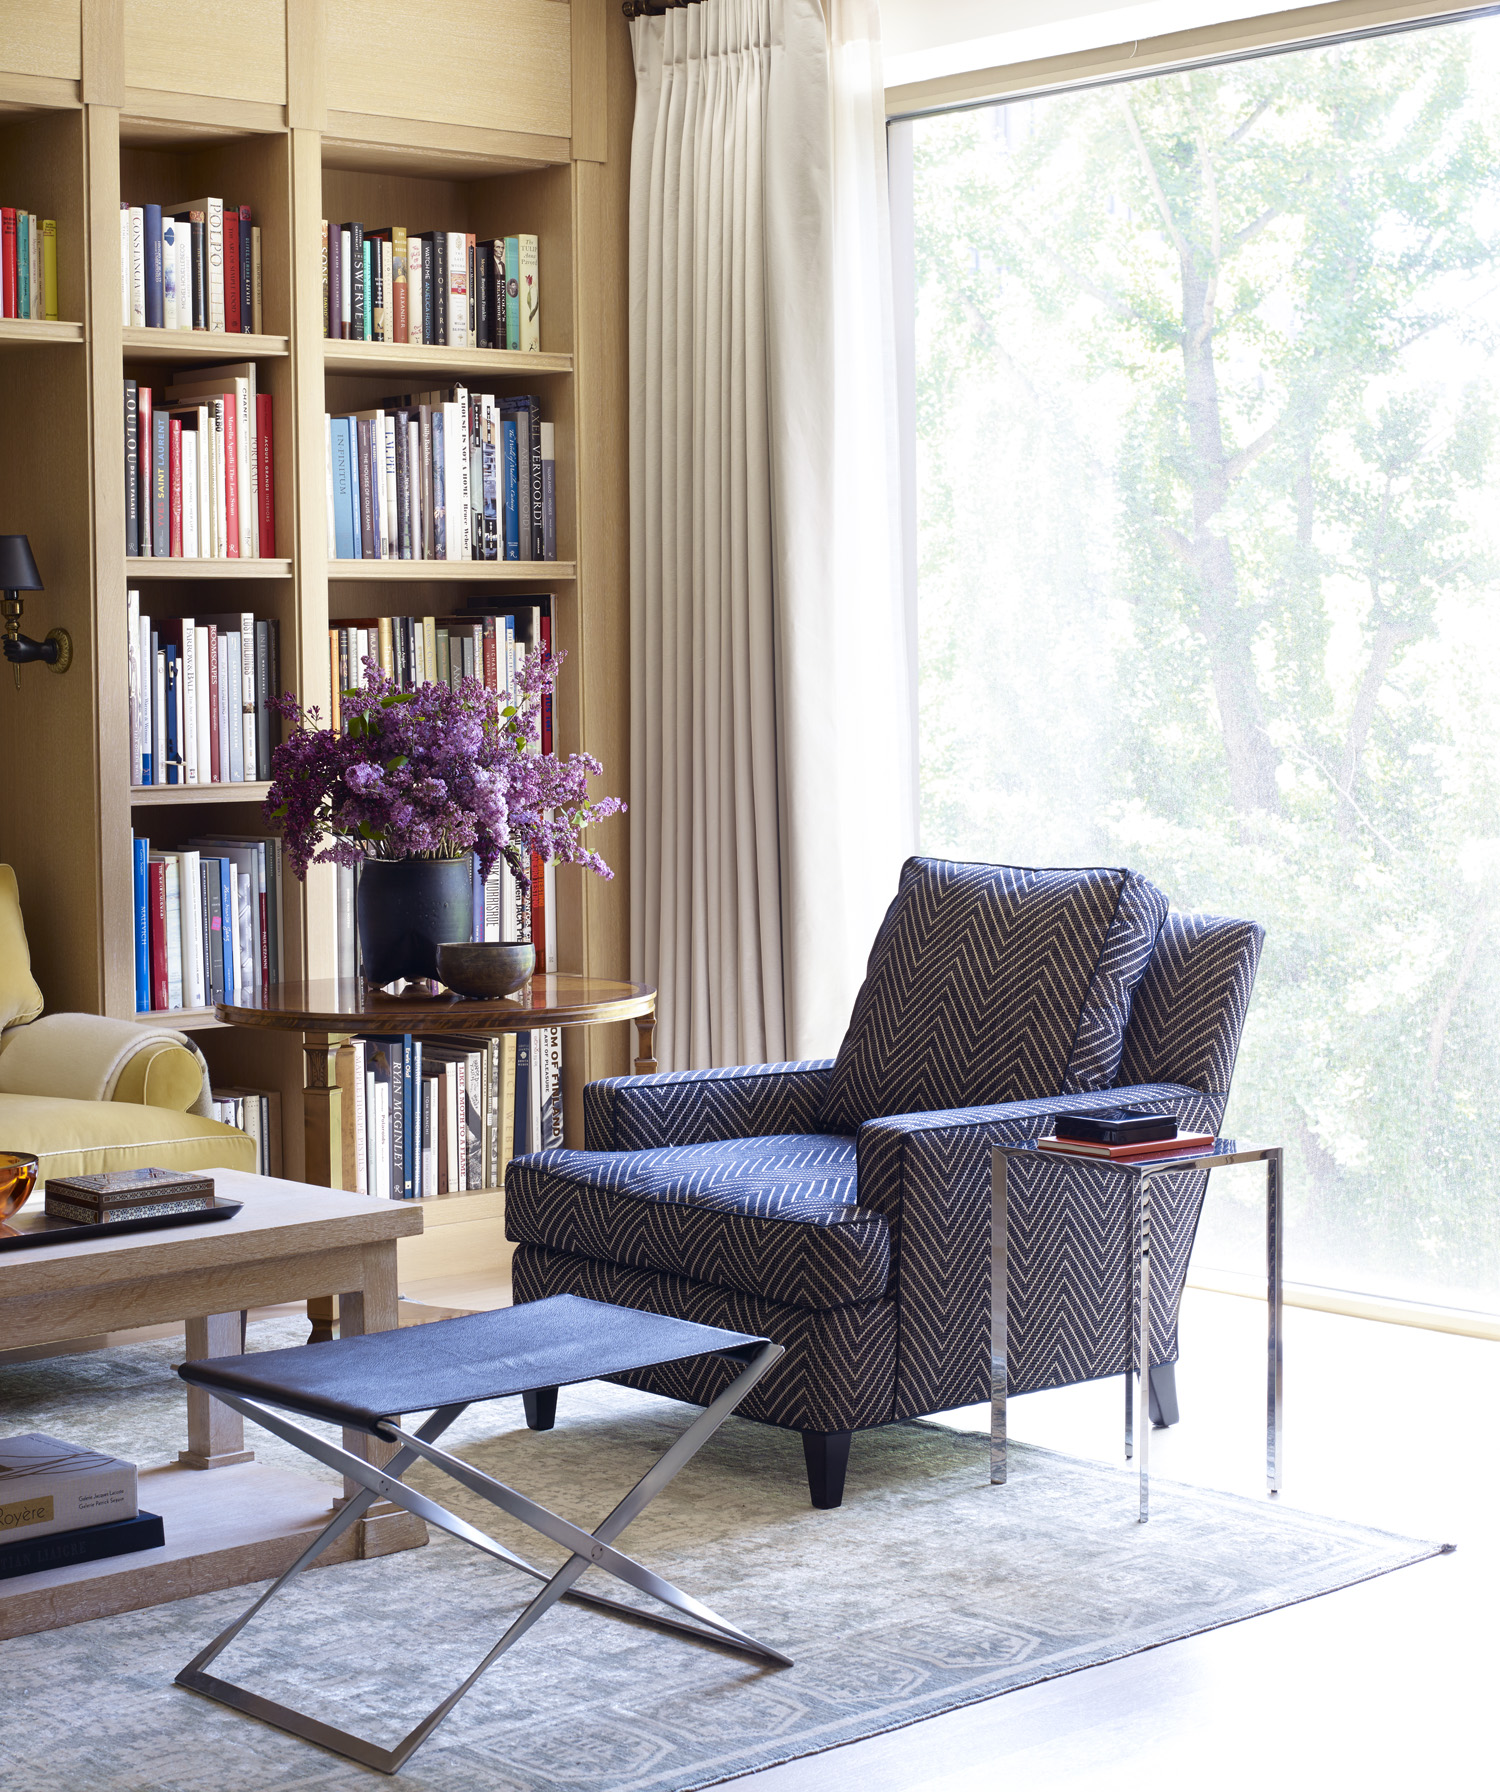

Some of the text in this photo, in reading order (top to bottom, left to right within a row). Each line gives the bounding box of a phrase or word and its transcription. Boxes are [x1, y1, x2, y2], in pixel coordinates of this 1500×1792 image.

[132, 217, 142, 289] CONSTANCIA
[210, 203, 222, 267] POLPO
[355, 261, 364, 320] SWERVE
[425, 270, 431, 280] ME
[126, 388, 138, 465] LOULOU
[215, 402, 223, 432] GARBO
[462, 434, 468, 443] IS
[227, 442, 235, 464] Agnelli
[251, 437, 259, 494] PORTRAITS
[385, 456, 396, 474] PEI
[423, 423, 432, 466] Billy Baldwin
[520, 447, 529, 471] AXEL
[531, 404, 544, 529] AXEL VERVOORDT
[131, 466, 135, 474] DE
[131, 477, 136, 487] LA
[157, 419, 166, 527] YVES SAINT LAURENT
[364, 489, 371, 497] OF
[522, 471, 531, 531] VERVOORDT
[210, 625, 218, 685] ROOMSCAPES
[243, 617, 255, 676] LOST BUILDINGS
[425, 623, 434, 679] CLASSIC CHINESE
[187, 671, 195, 694] BALL
[486, 878, 500, 927] MORRISROE
[515, 904, 523, 926] JACK
[506, 1045, 516, 1099] BRUCE
[544, 1049, 549, 1058] OF
[550, 1027, 561, 1137] OM OF FINLAND
[355, 1056, 366, 1173] MAPPLETHORPE PISTILS
[392, 1061, 404, 1170] RYAN MCGINLEY
[459, 1124, 466, 1137] TO
[78, 1494, 93, 1502] Galerie
[93, 1492, 109, 1500] Jacques
[78, 1501, 95, 1510] Galerie
[95, 1498, 110, 1506] Patrick
